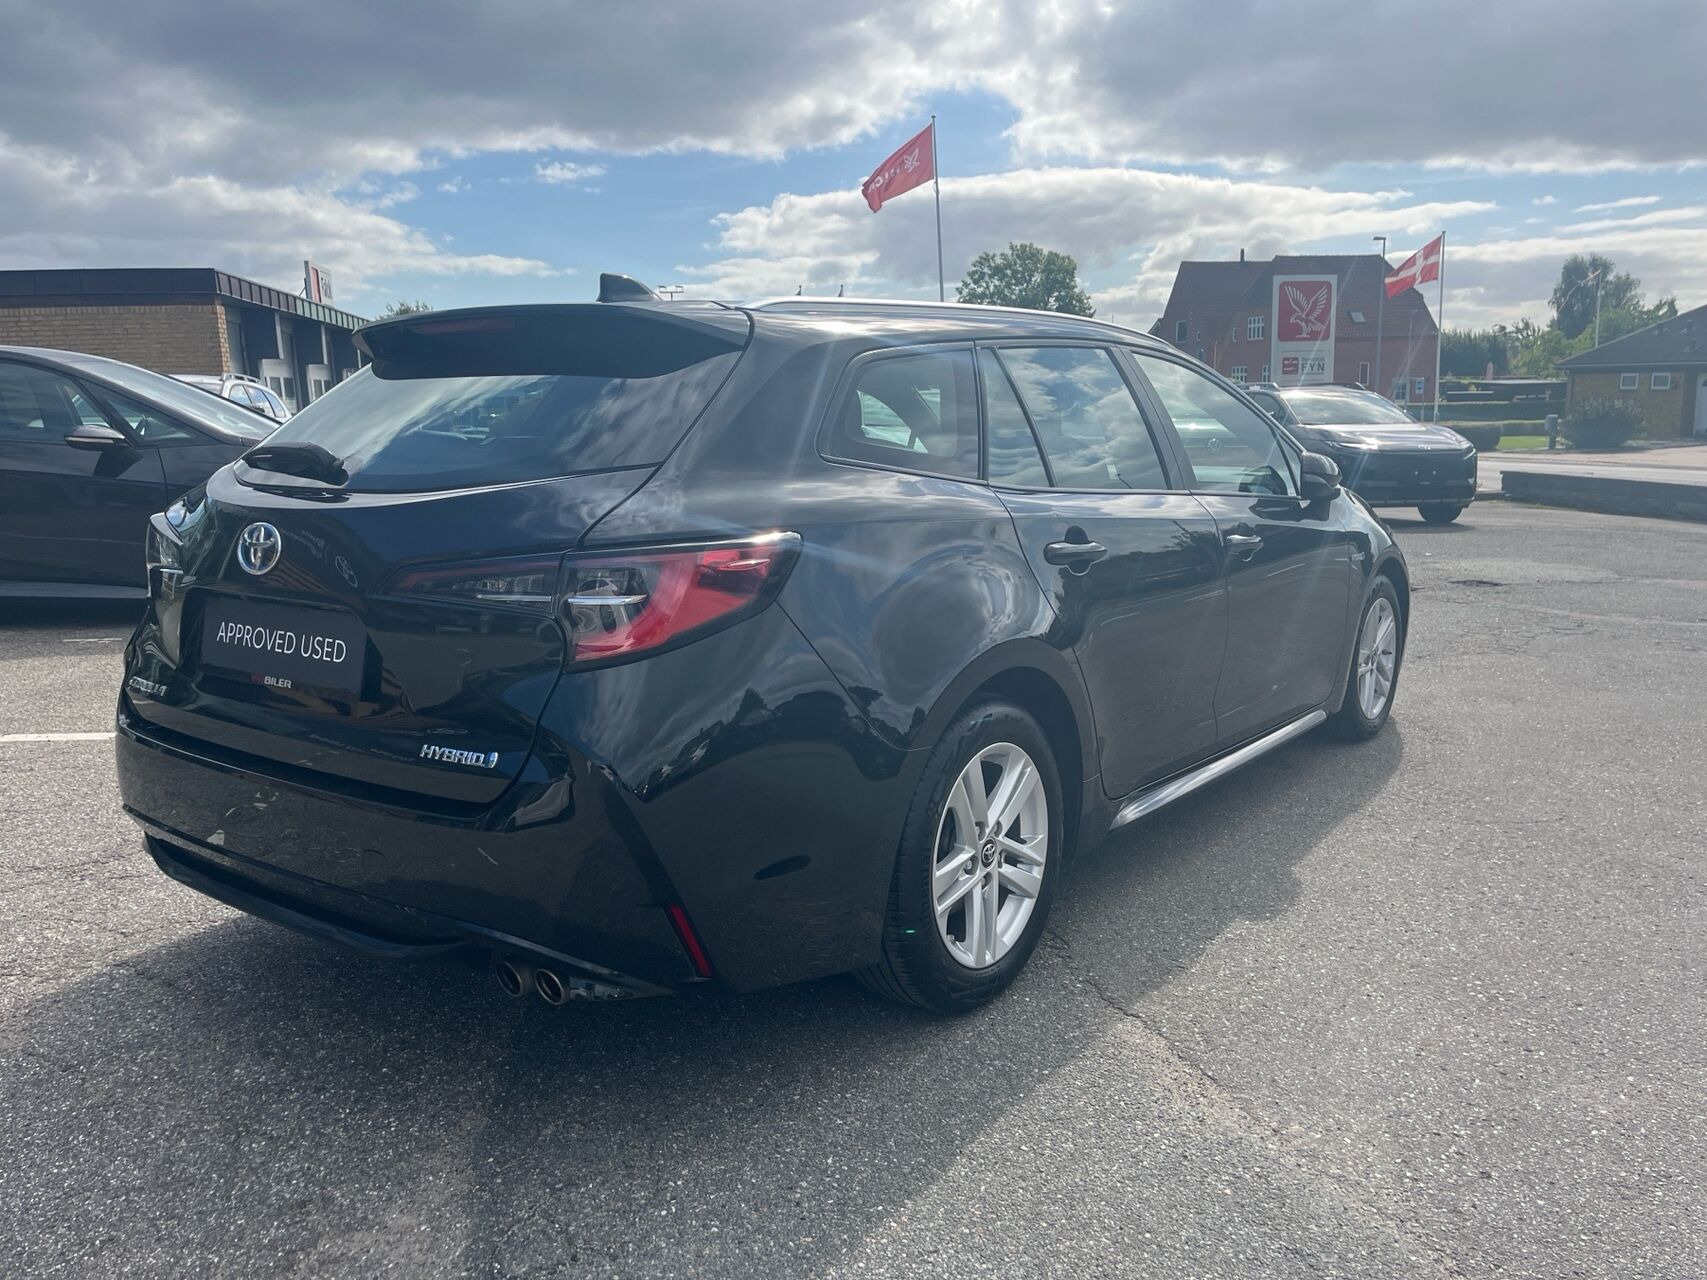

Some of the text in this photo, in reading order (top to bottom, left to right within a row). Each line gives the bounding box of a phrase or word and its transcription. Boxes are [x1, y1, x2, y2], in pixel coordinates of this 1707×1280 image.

[1301, 362, 1325, 372] FYN
[216, 621, 347, 663] APPROVED USED
[419, 744, 486, 766] HYBRID
